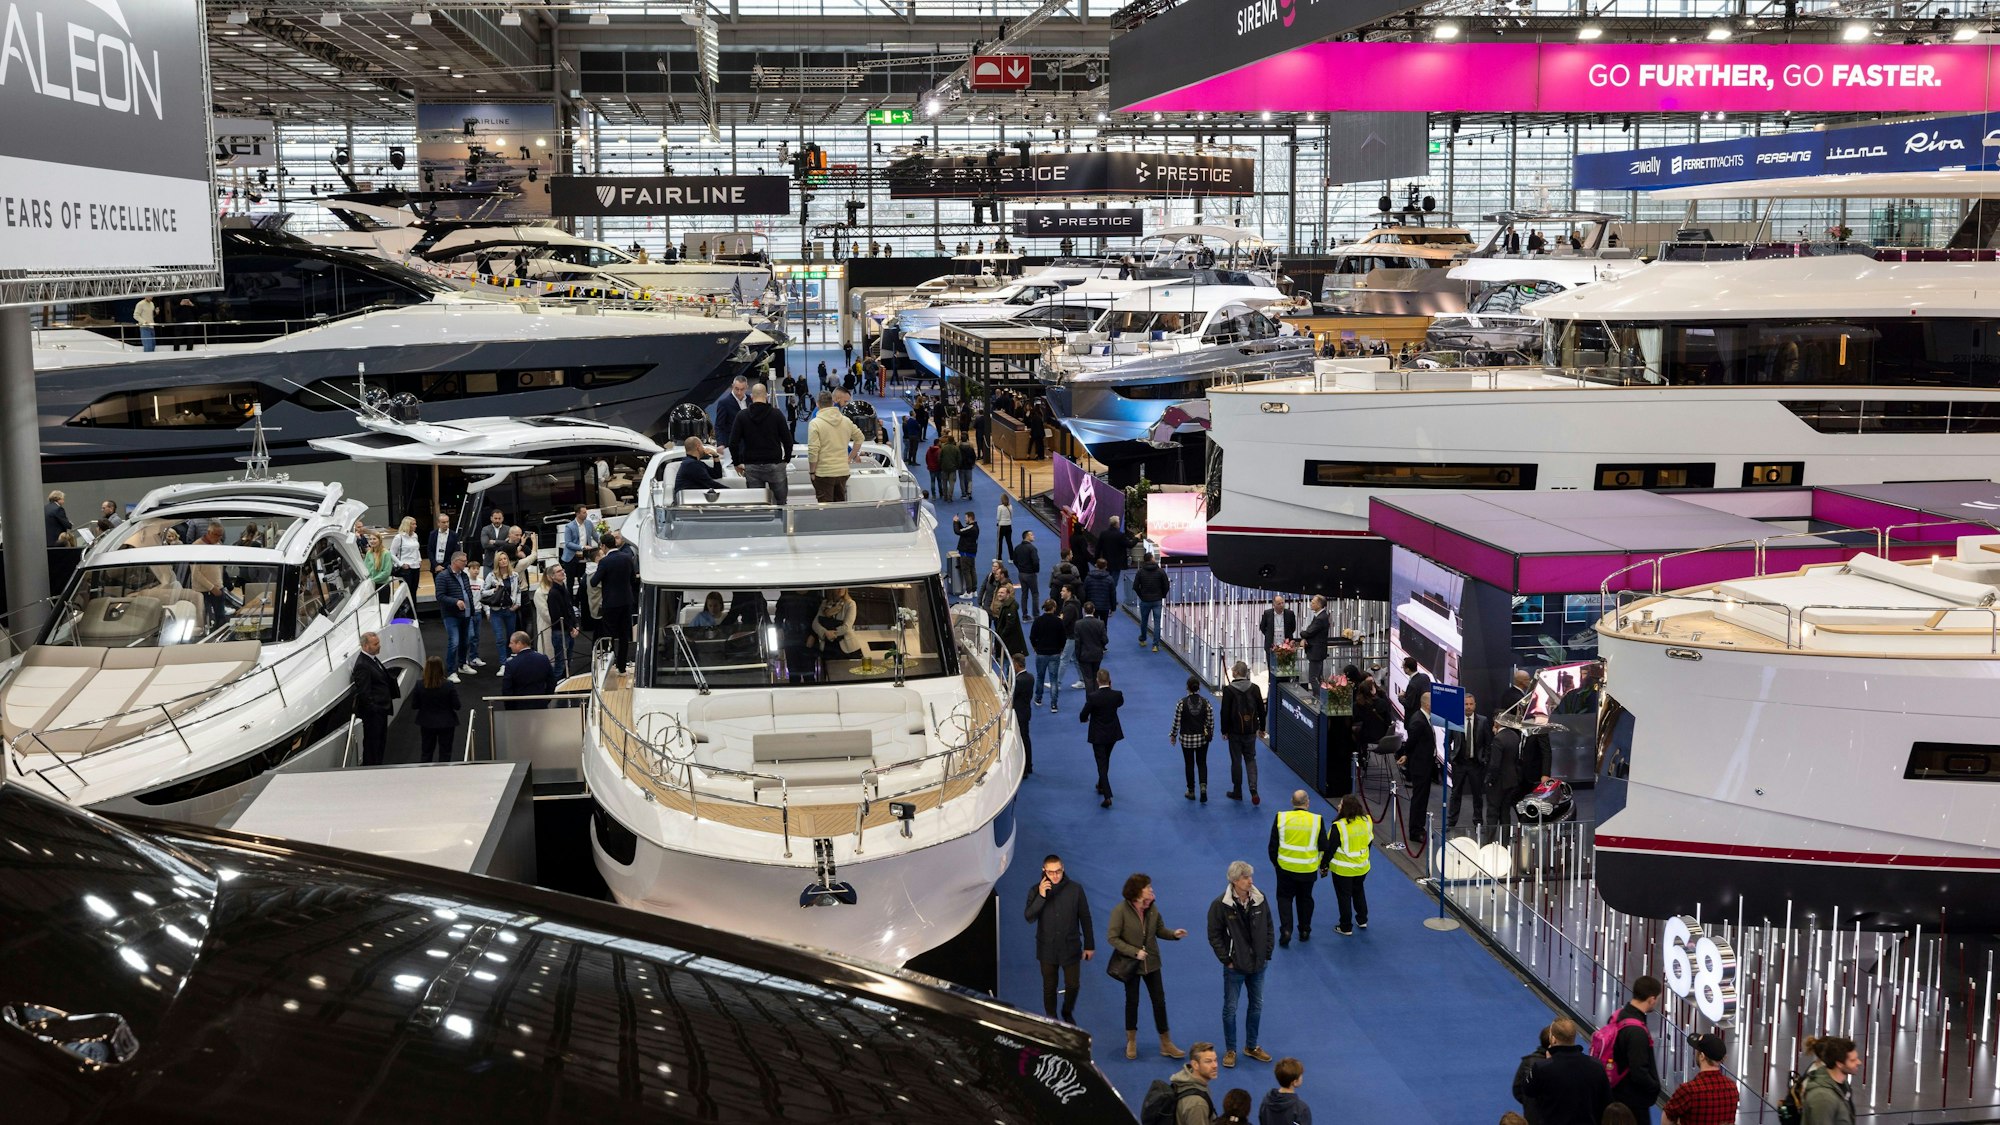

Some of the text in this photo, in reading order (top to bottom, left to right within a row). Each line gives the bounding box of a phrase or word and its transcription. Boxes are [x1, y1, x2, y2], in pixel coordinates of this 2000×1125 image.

[1237, 0, 1278, 36] SIRENA
[0, 3, 163, 121] ALEON
[1588, 63, 1942, 91] GO FURTHER, GO FASTER.
[1638, 156, 1661, 176] wally
[1756, 150, 1812, 165] PERSHING
[1825, 145, 1888, 160] itama
[1904, 130, 1966, 154] Riva
[1157, 166, 1233, 183] PRESTIGE
[621, 186, 746, 205] FAIRLINE
[0, 196, 177, 232] EARS OF EXCELLENCE
[1058, 216, 1133, 227] PRESTIGE
[1663, 915, 1727, 1022] 68
